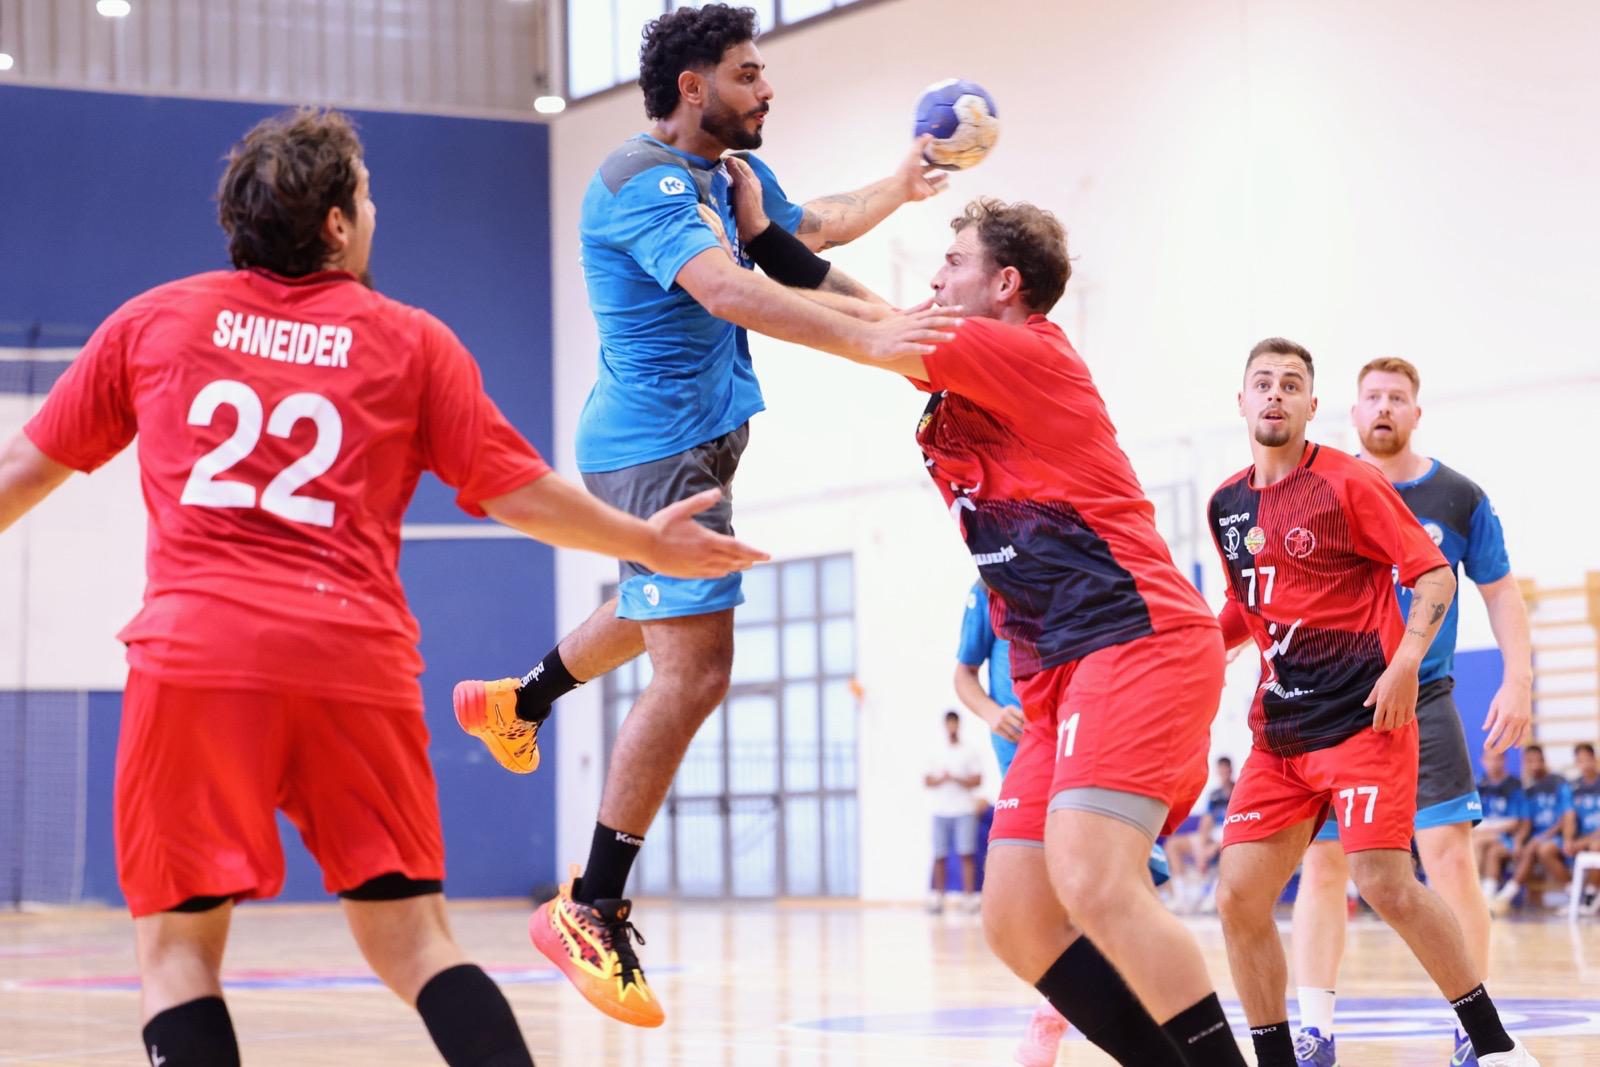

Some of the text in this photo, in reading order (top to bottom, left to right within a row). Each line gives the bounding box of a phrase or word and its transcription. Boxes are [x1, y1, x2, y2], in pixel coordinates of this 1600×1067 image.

[212, 309, 353, 369] SHNEIDER
[179, 379, 343, 528] 22
[1241, 565, 1276, 607] 77
[1339, 785, 1379, 828] 77
